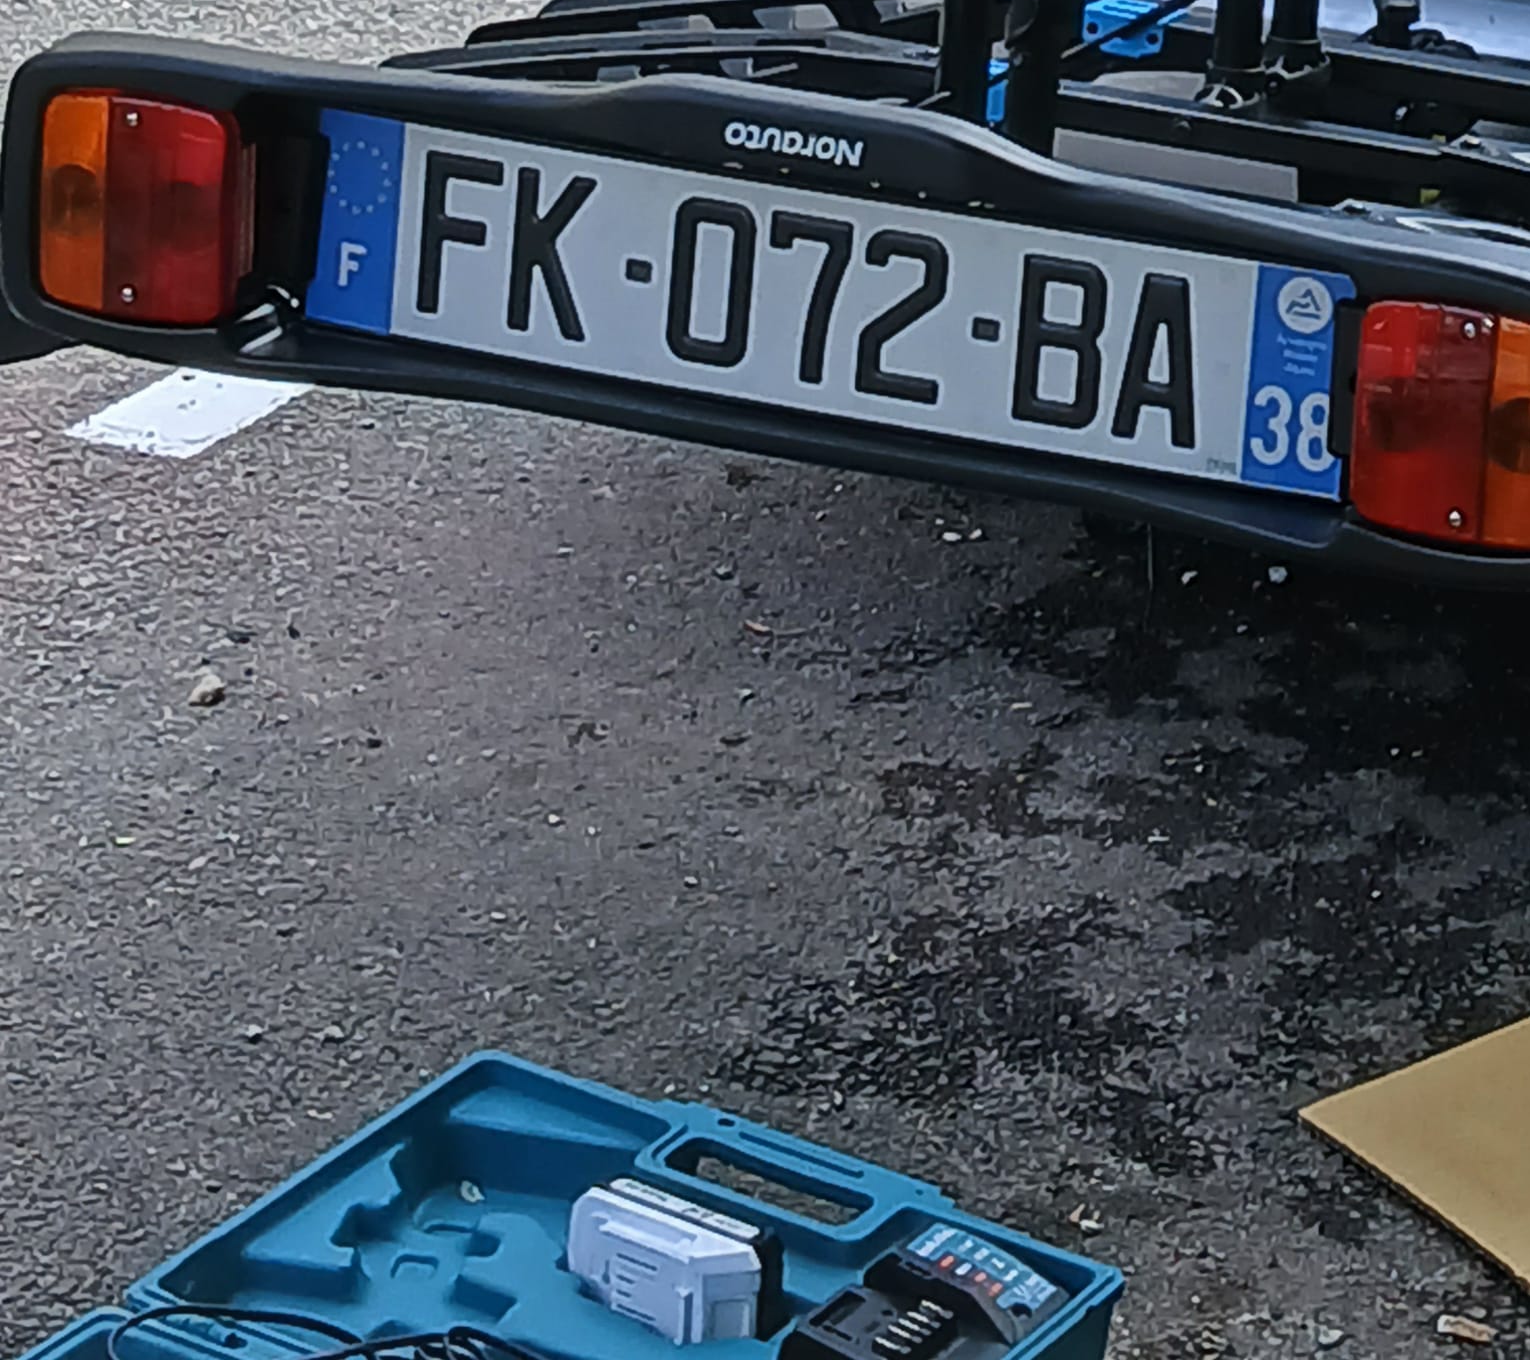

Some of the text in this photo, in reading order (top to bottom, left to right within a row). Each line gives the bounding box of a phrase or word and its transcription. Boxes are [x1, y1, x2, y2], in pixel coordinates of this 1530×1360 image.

[723, 122, 864, 167] Norauto
[337, 242, 367, 286] F
[415, 150, 1197, 450] FK-072-BA
[1250, 384, 1336, 472] 38
